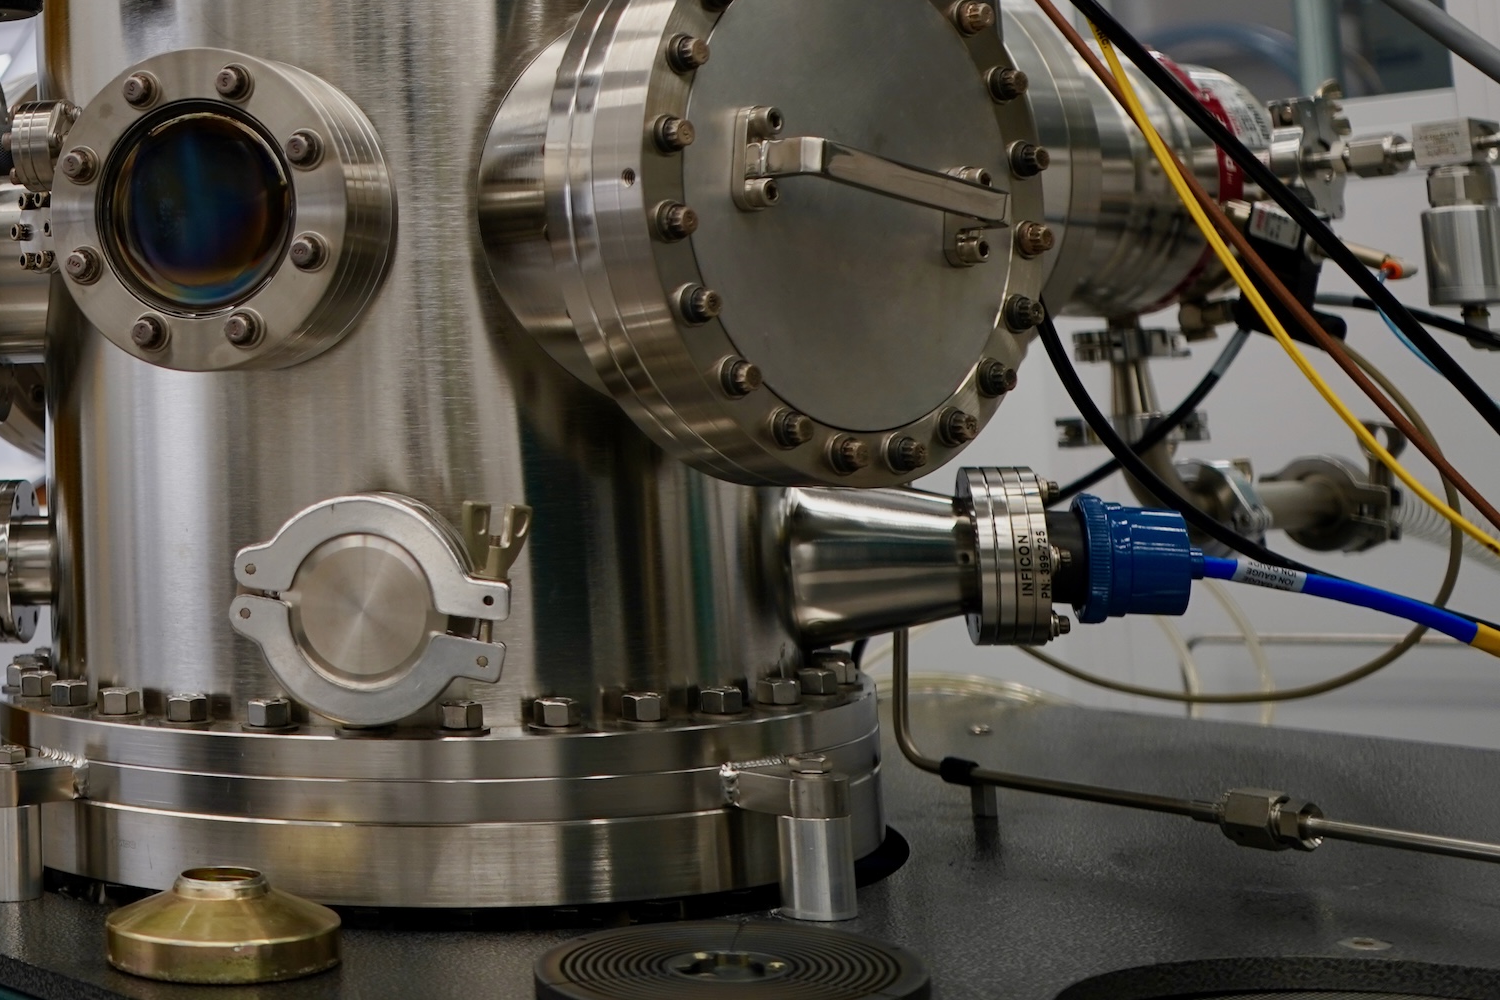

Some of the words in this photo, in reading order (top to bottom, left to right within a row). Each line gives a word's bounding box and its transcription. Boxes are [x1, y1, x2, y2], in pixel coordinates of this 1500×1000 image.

[1017, 535, 1034, 597] INFICON
[1036, 530, 1050, 575] 399-725
[1245, 567, 1278, 583] GAUGE
[1277, 576, 1295, 587] ION
